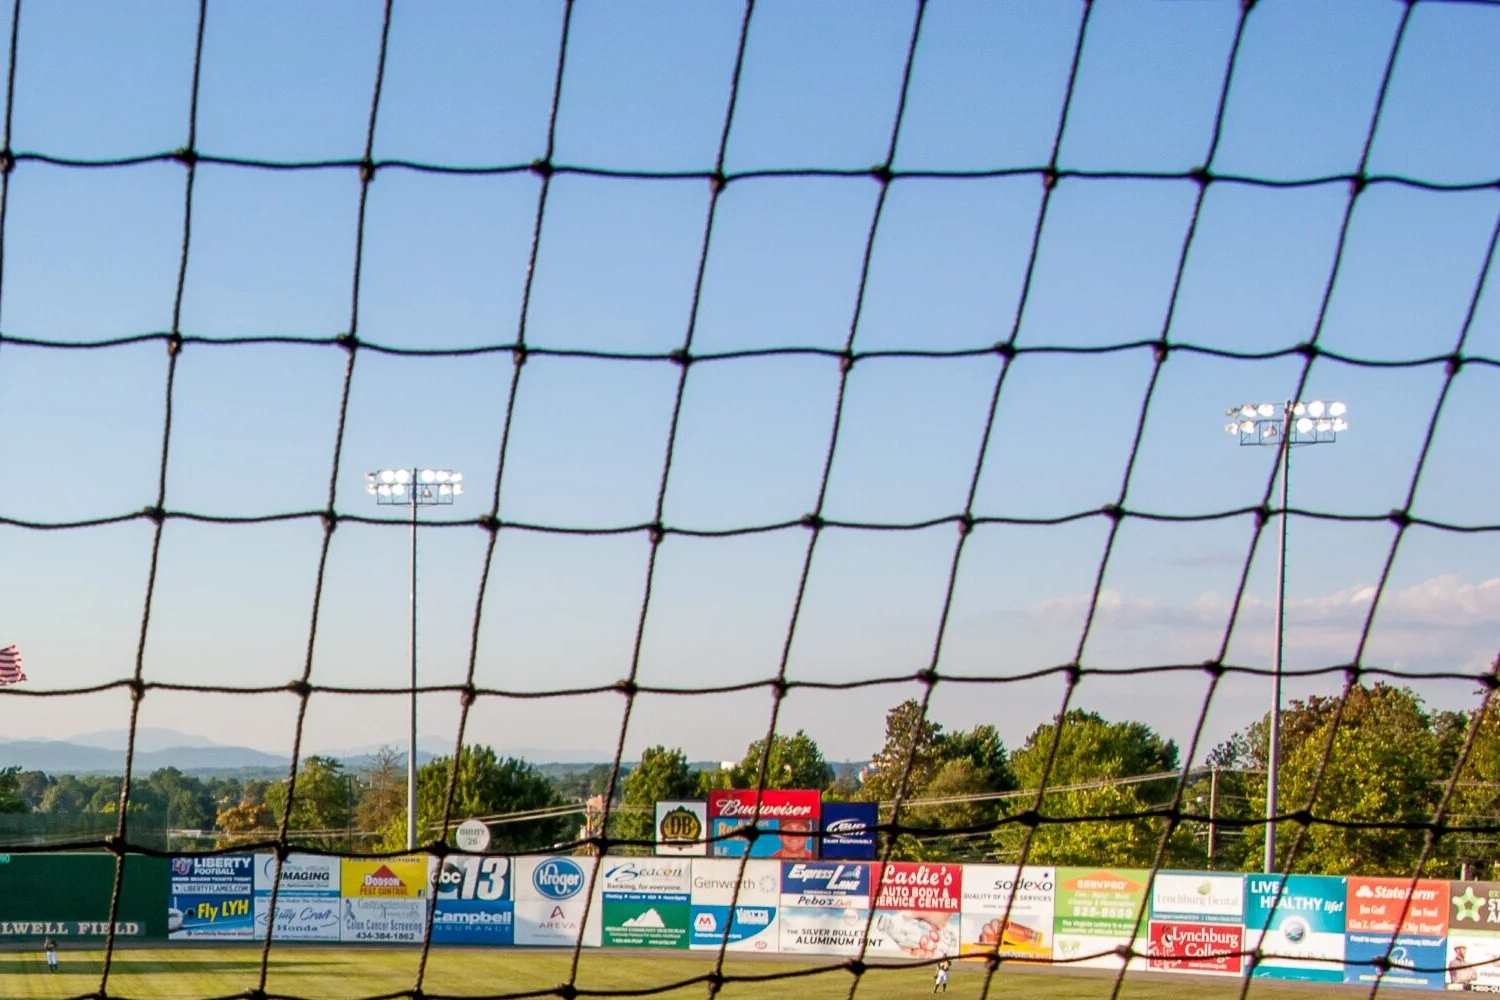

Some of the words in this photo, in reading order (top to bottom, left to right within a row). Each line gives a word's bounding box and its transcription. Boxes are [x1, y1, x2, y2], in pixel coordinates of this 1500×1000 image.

[716, 799, 811, 817] Budweiser
[194, 857, 251, 868] LIBERTY
[280, 872, 330, 881] IMAGING
[463, 857, 509, 901] 13
[540, 864, 580, 894] Kroger
[789, 864, 834, 882] Express
[882, 865, 953, 886] Laslie's
[182, 884, 249, 892] LIBERTYFLAMES.COM
[1077, 879, 1125, 889] SERVPRO
[1251, 881, 1280, 894] LIVE
[881, 887, 909, 898] AUTO
[912, 887, 940, 898] BODY
[942, 888, 950, 898] &
[798, 896, 833, 906] Pebo's
[918, 898, 958, 909] CENTER
[1157, 894, 1205, 906] Lynchburg
[1208, 895, 1239, 906] Dental
[197, 902, 218, 922] Fly
[221, 899, 249, 917] LYH
[1323, 900, 1344, 914] life!
[434, 911, 511, 925] Campbell
[77, 922, 139, 935] FIELD
[276, 924, 318, 932] Honda
[347, 921, 365, 931] Colon
[366, 921, 388, 931] Cancer
[390, 921, 422, 934] Screening
[832, 929, 865, 937] BULLET
[795, 937, 854, 946] ALUMINUM
[1173, 926, 1239, 949] Lynchburg
[1185, 943, 1231, 964] College
